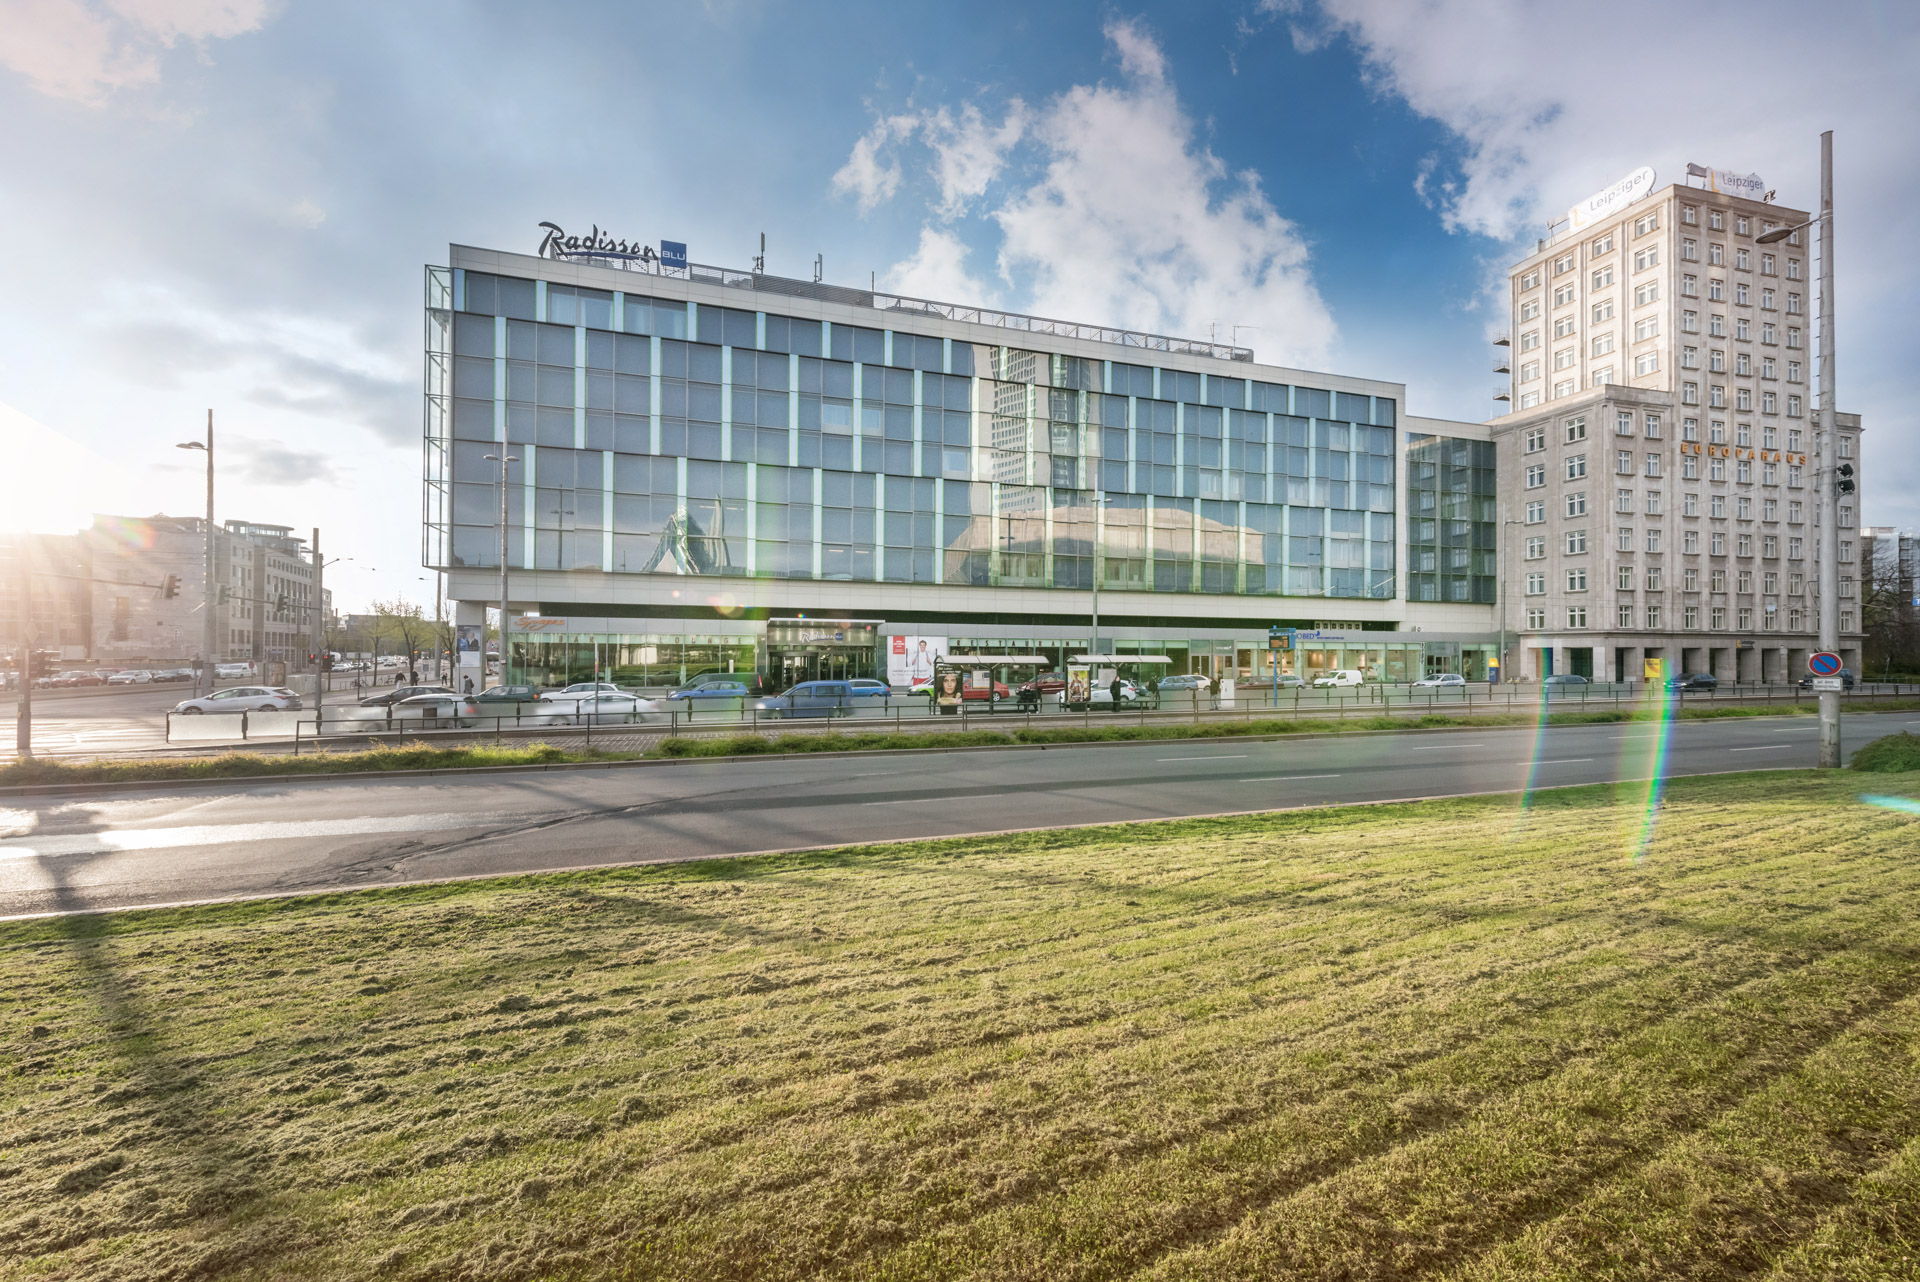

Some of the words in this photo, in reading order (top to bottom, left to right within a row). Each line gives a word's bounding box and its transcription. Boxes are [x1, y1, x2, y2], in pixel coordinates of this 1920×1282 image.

[1590, 170, 1649, 211] Leipziger
[1722, 173, 1763, 191] Leipziger
[538, 221, 659, 260] Radisson
[662, 250, 686, 261] BLU
[1681, 442, 1807, 465] EUROPAHAUS
[558, 635, 595, 643] BAR
[659, 635, 742, 645] LOUNGE
[956, 639, 1082, 648] RESTAURANT
